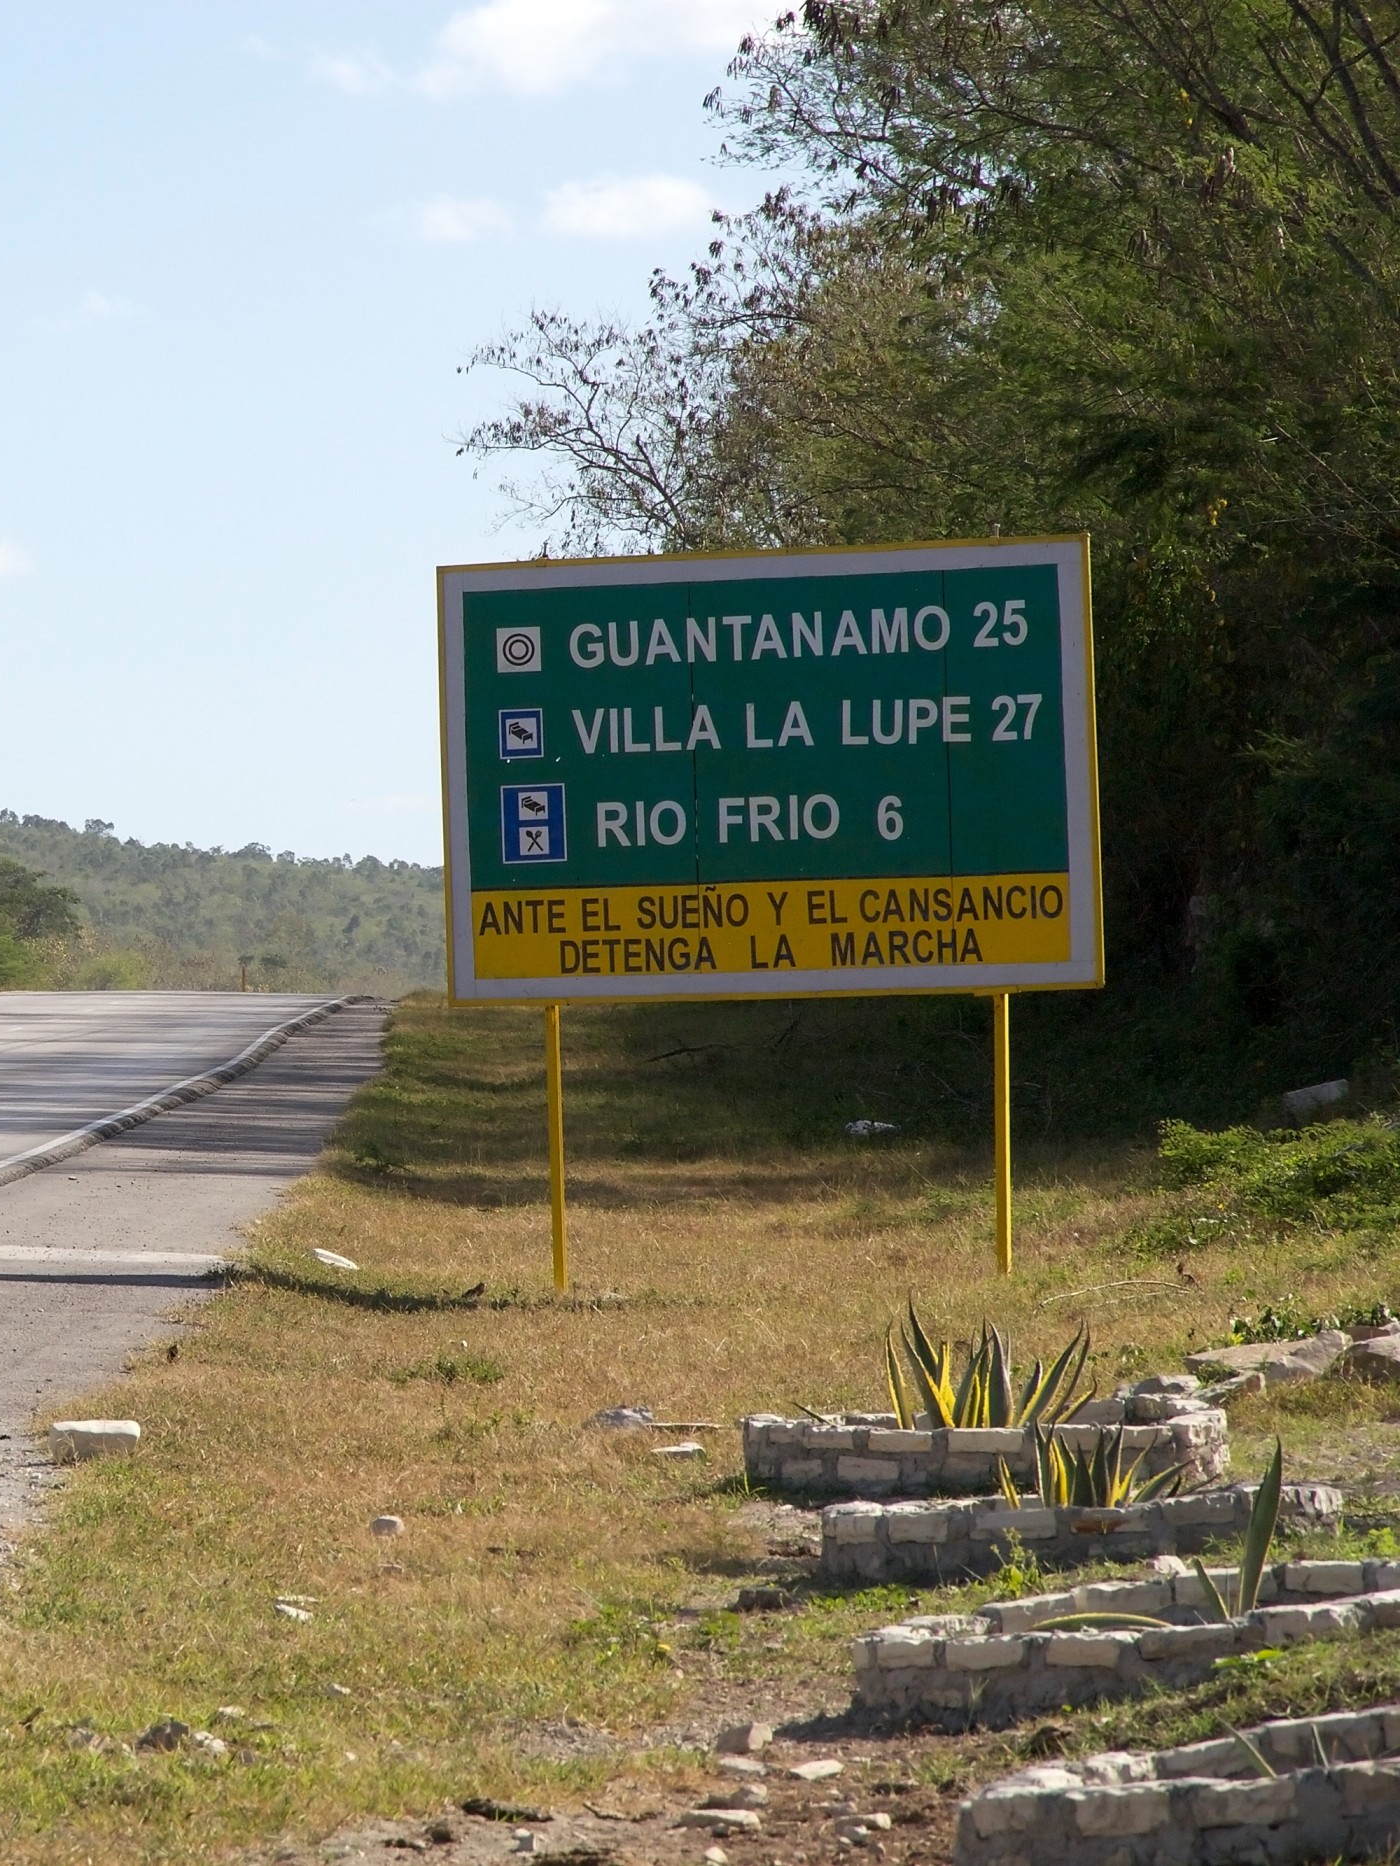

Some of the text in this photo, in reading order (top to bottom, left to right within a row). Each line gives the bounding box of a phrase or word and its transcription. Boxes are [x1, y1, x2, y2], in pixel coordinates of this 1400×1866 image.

[571, 600, 1027, 668] GUANTANAMO 25
[572, 694, 1043, 753] VILLA LA LUPE 27
[597, 794, 903, 847] RIO FRIO 6
[479, 885, 1063, 935] ANTE EL SUEÑO Y EL CANSANCIO
[561, 928, 983, 974] DETENGA LA MARCHA
